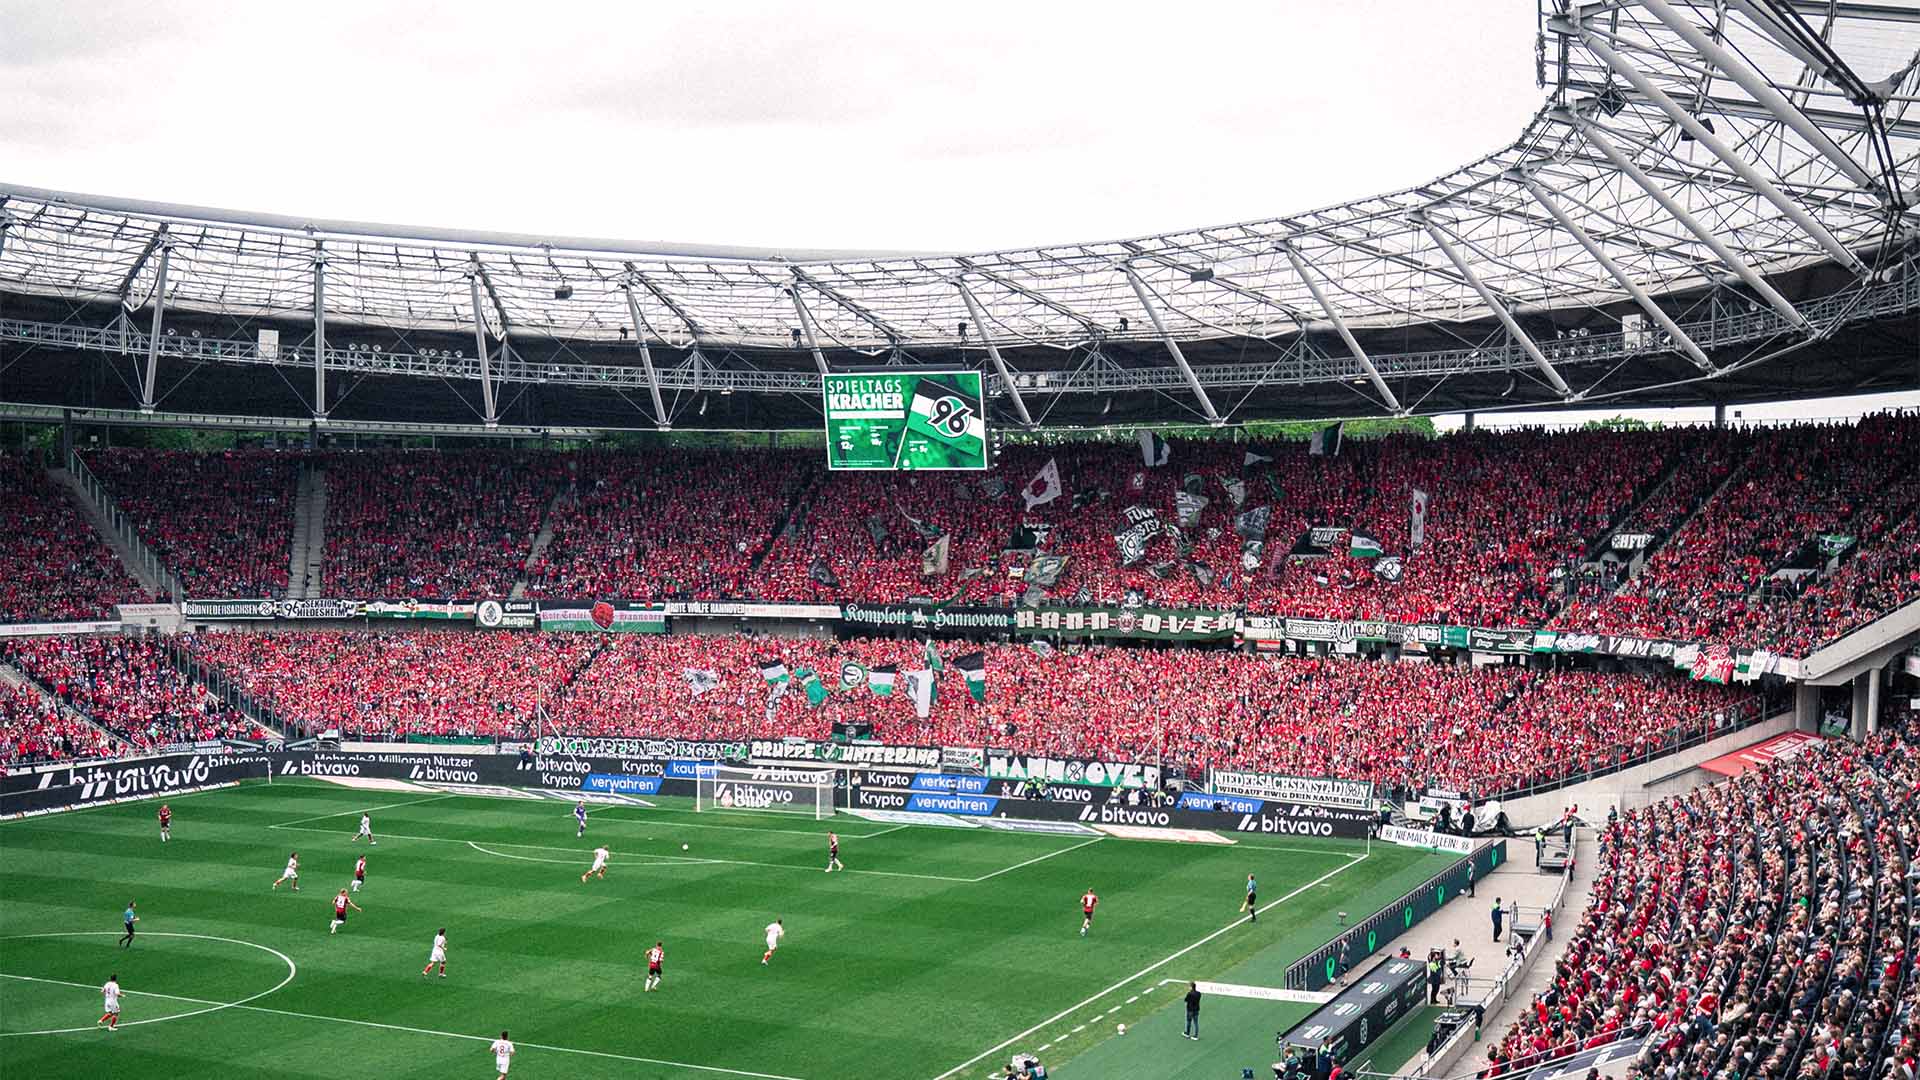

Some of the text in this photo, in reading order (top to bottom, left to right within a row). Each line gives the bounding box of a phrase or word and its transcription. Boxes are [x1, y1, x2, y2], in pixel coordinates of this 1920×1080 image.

[828, 380, 901, 393] SPIELTAGS
[829, 393, 904, 410] KRACHER
[931, 400, 970, 433] 96
[186, 604, 258, 615] SÜDNIEDERSACHSEN
[297, 607, 346, 617] HILDESHEIM
[305, 600, 337, 608] SEKTION
[670, 603, 687, 614] ROTE
[687, 602, 709, 614] WÖLFE
[710, 604, 745, 614] HANNOVER
[845, 603, 1008, 630] Komplott Hannovera
[1286, 623, 1334, 635] Ensemble
[664, 739, 725, 759] SIEGEN
[752, 741, 815, 759] GRUPPE
[842, 746, 940, 766] UNTERRANG
[301, 760, 360, 775] bitvavo
[433, 755, 474, 767] Nutzer
[536, 757, 591, 773] bitvavo
[622, 760, 664, 776] Krypto
[426, 764, 478, 783] bitvavo
[542, 773, 654, 791] Krypto verwahren
[771, 767, 828, 783] bitvavo
[868, 772, 910, 787] Krypto
[734, 784, 793, 802] bitvavo
[860, 792, 988, 811] Krypto verwahren
[1219, 786, 1363, 806] WIRD AUF EWIG DEIN NAME SEIN
[1186, 796, 1253, 813] verwhren
[1101, 805, 1169, 826] bitvavo
[1261, 814, 1333, 836] bitvavo
[1394, 830, 1428, 845] NIEMALS
[1429, 835, 1459, 849] ALLEIN!
